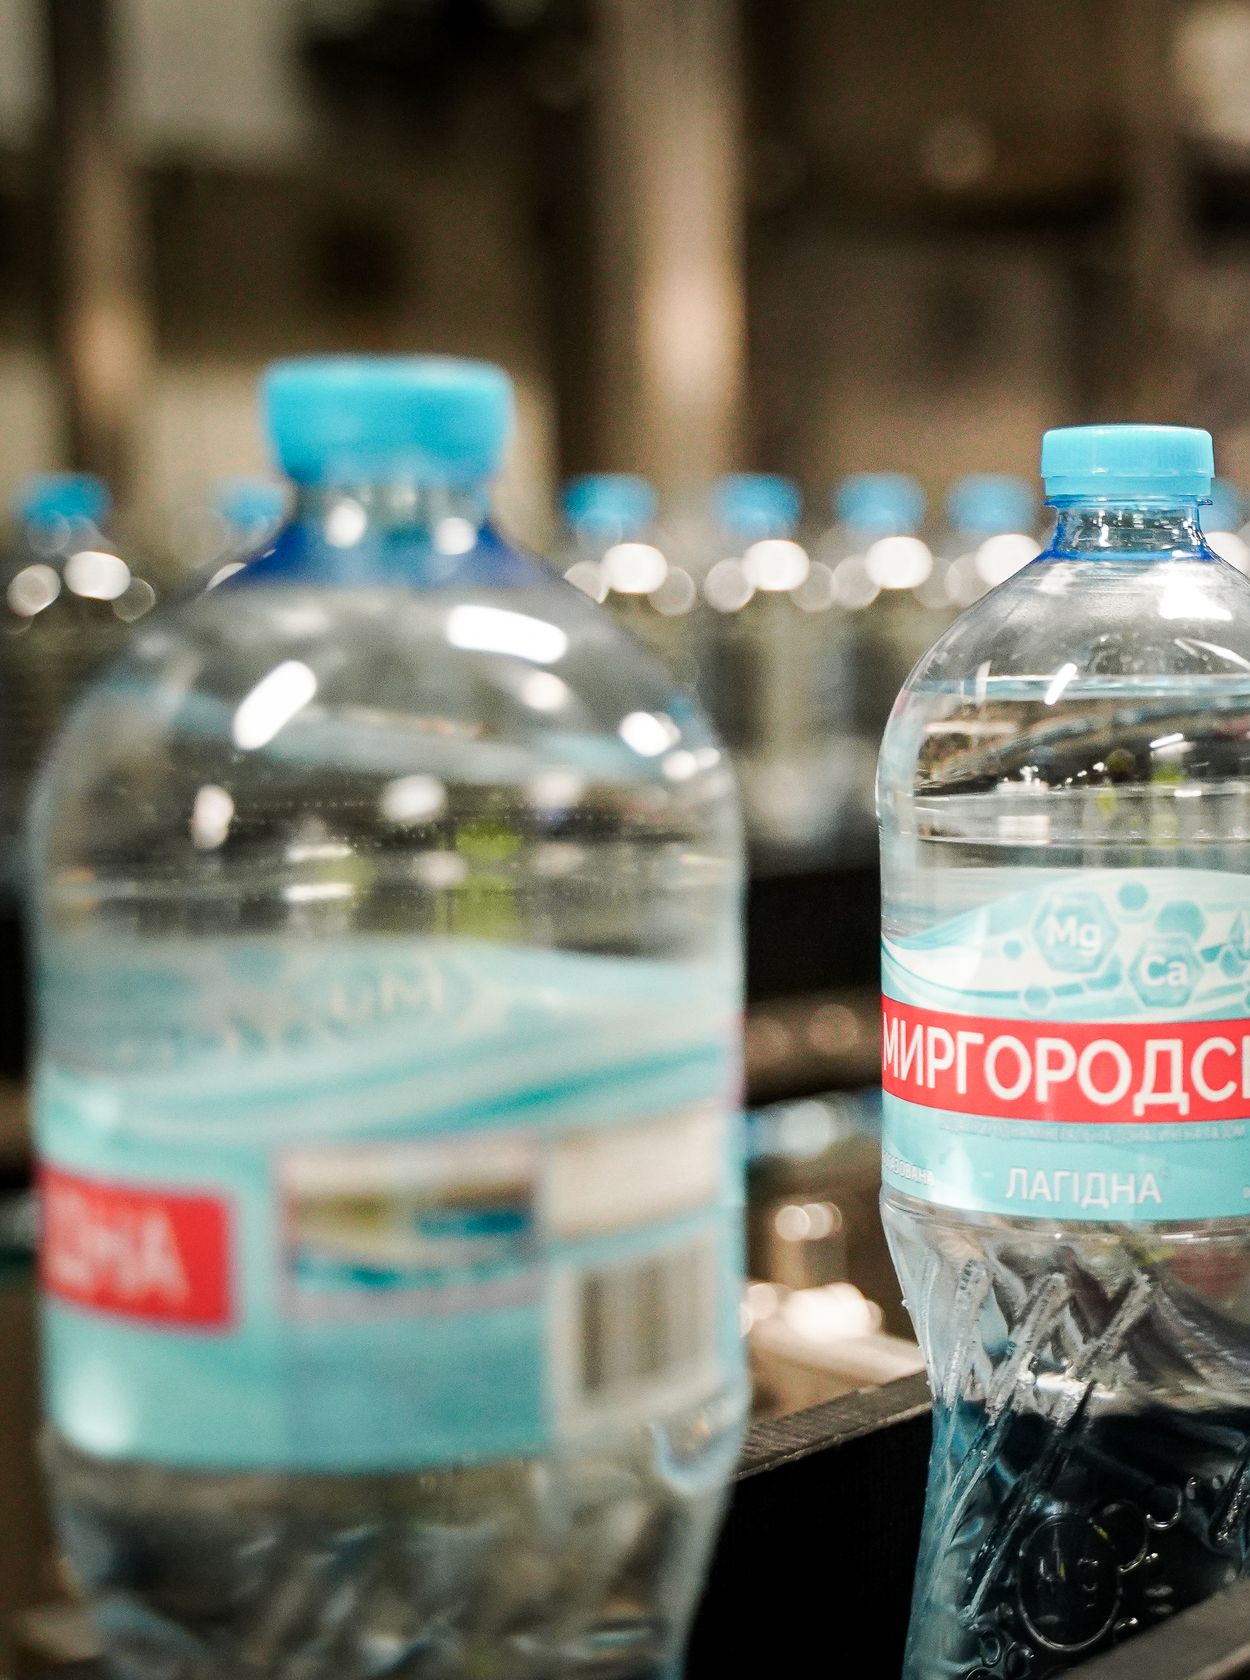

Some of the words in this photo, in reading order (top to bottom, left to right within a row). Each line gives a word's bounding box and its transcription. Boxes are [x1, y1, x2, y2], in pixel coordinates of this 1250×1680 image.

[1046, 912, 1102, 956] Mg
[1139, 952, 1190, 986] Ca
[1004, 1167, 1163, 1209] ЛАГІДНА
